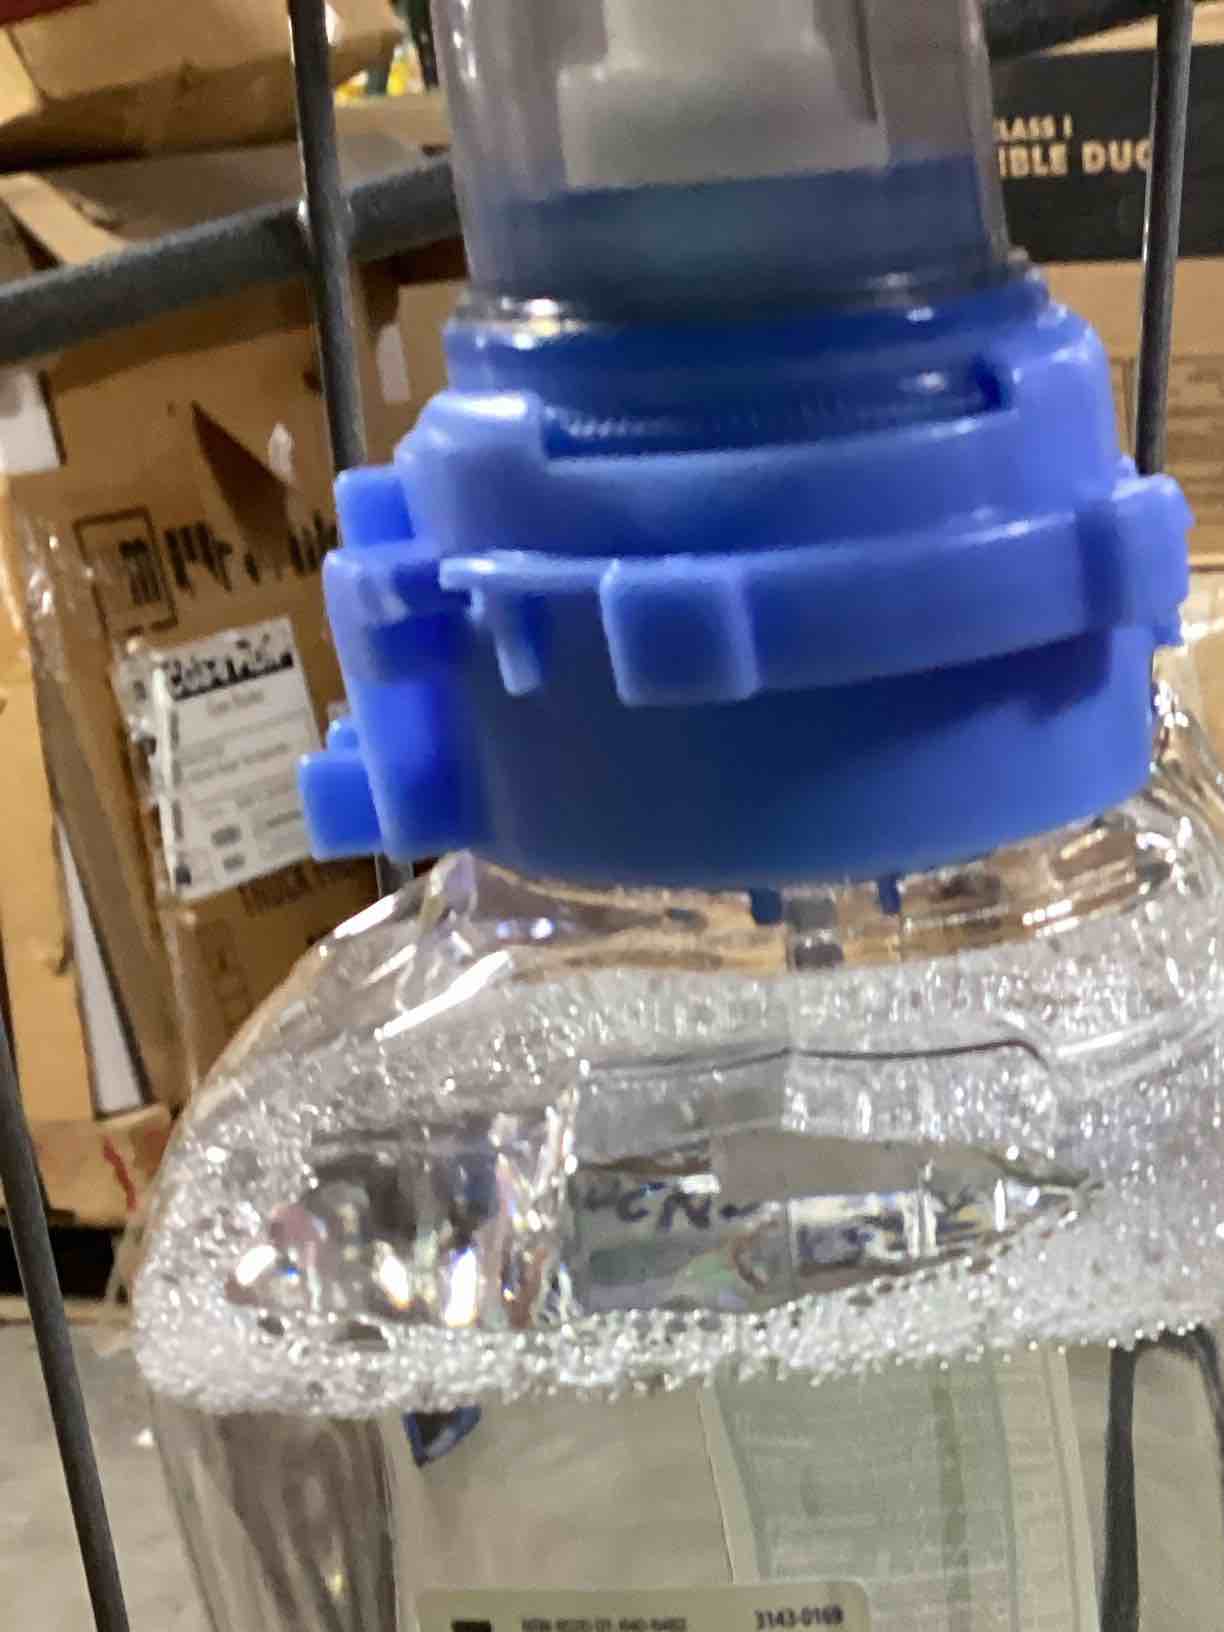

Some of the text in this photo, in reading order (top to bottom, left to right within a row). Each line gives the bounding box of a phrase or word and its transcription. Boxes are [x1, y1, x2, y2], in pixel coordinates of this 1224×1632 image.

[993, 115, 1055, 140] LASS
[998, 137, 1153, 178] IBLE DUC
